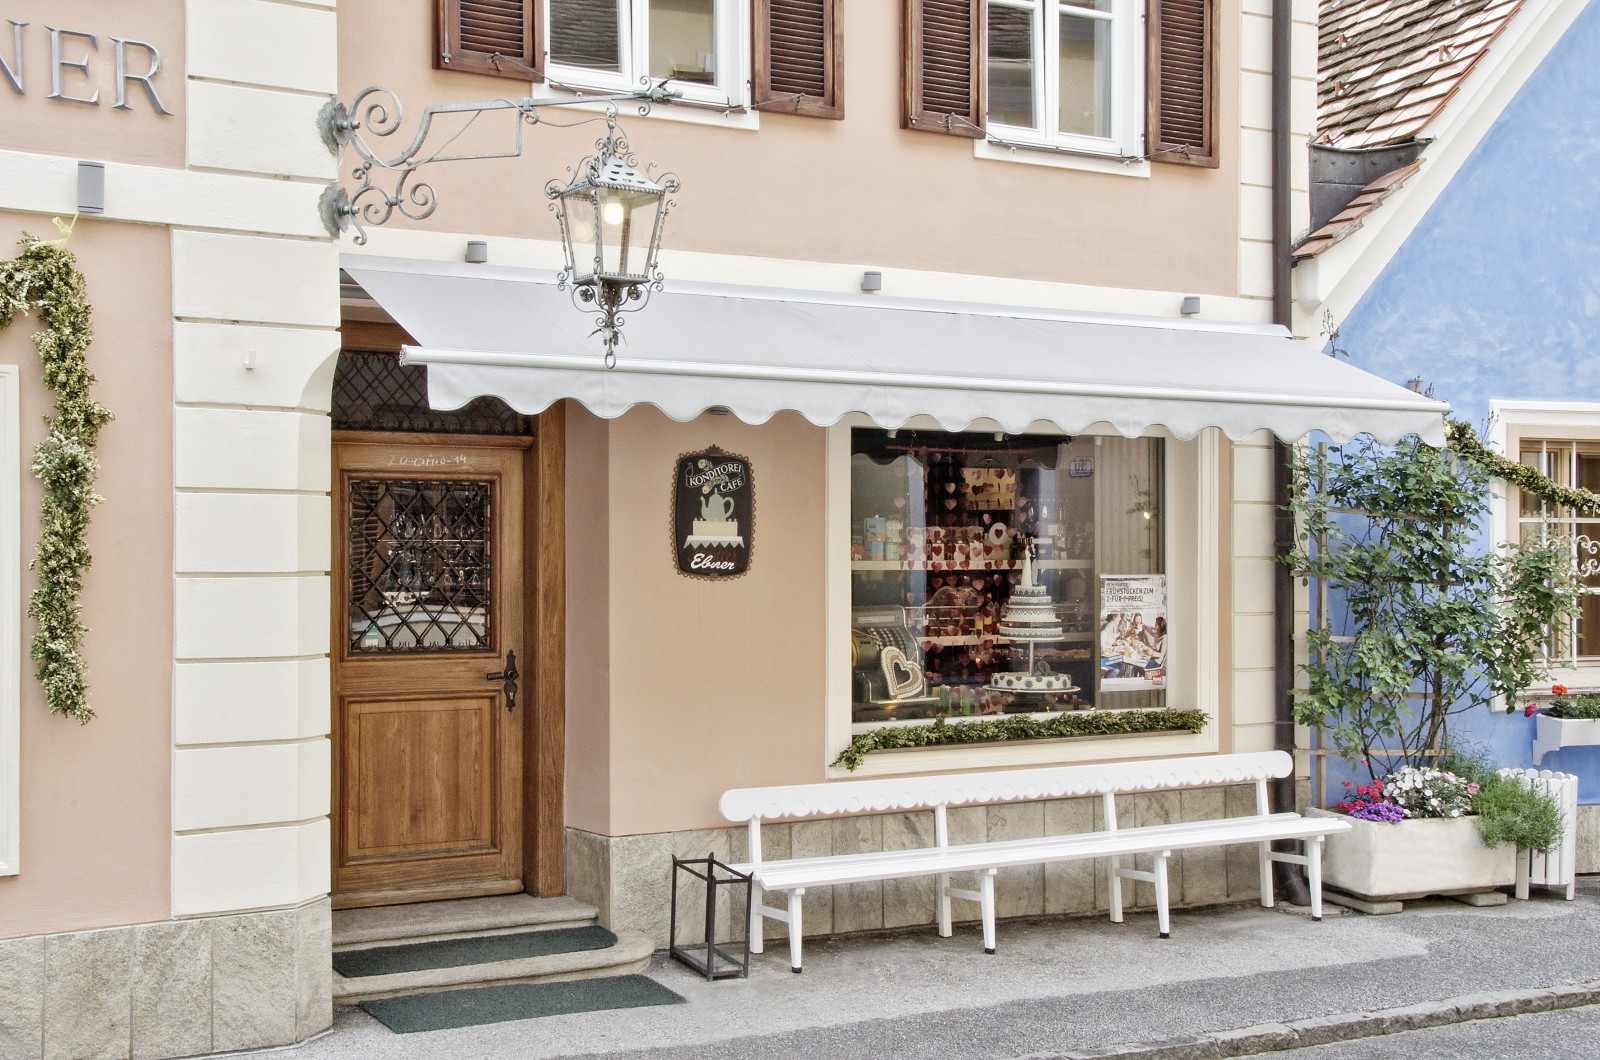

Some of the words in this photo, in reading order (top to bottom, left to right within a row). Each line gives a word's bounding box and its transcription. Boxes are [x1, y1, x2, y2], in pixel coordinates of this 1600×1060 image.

[689, 463, 741, 486] KONDITOREI
[690, 553, 735, 570] Ebner
[1106, 586, 1143, 595] FRÜHSTÜCKEN
